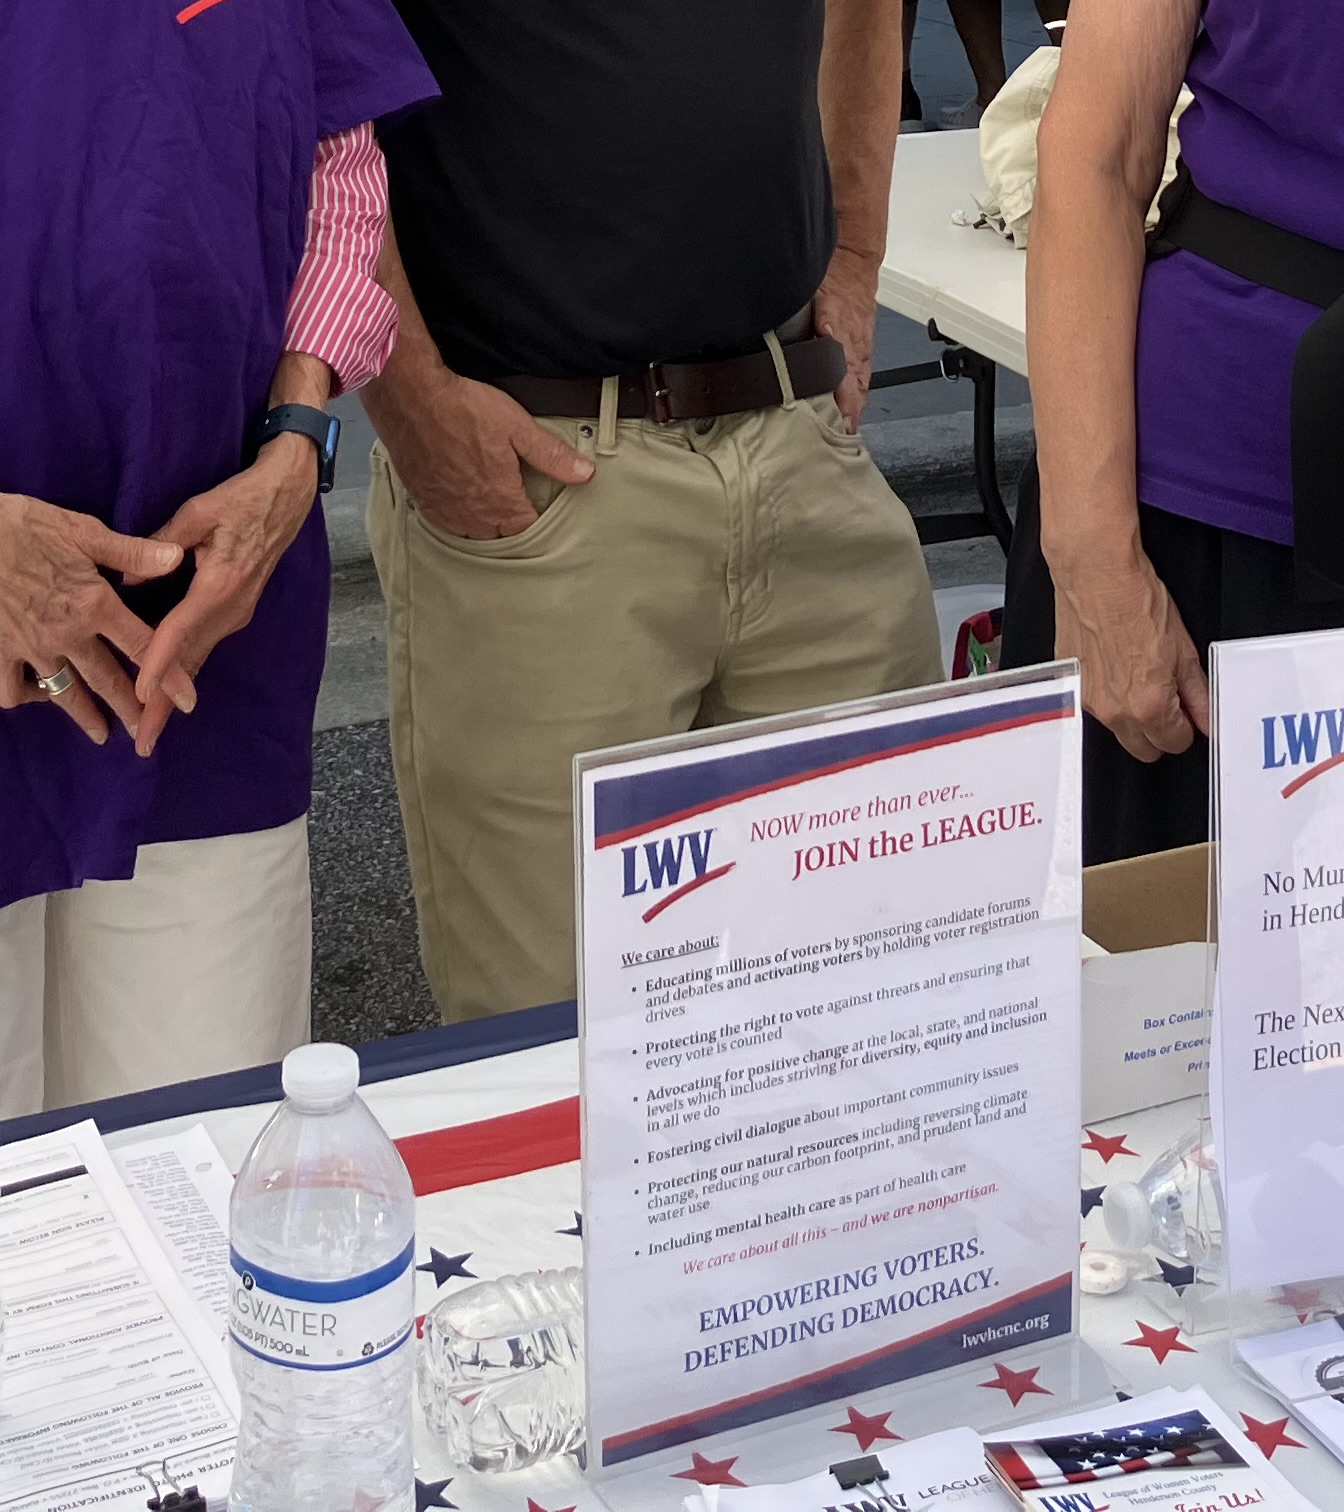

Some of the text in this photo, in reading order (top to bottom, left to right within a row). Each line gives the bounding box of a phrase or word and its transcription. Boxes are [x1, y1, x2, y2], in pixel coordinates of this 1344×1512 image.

[750, 812, 804, 843] NOW
[808, 805, 861, 831] more
[867, 794, 911, 819] than
[791, 801, 1043, 881] JOIN the LEAGUE.
[621, 828, 714, 898] LWV
[1262, 871, 1295, 896] No
[1262, 909, 1282, 932] in
[621, 951, 643, 966] We
[645, 946, 675, 961] care
[645, 897, 1031, 993] Educating millions of voters by sponsoring candidate forums
[645, 910, 1040, 1009] and debates and activating voters by holding voter registration
[645, 1005, 686, 1024] drives
[1144, 1018, 1165, 1029] Box
[1254, 1010, 1296, 1036] The
[1160, 1044, 1172, 1055] or
[1253, 1039, 1342, 1071] Election
[648, 1163, 967, 1256] Including mental health care as part of health care
[683, 1258, 704, 1275] We
[707, 1252, 736, 1269] care
[739, 1239, 779, 1261] about
[781, 1231, 799, 1249] all
[801, 1226, 827, 1244] this
[842, 1213, 868, 1233] and
[870, 1210, 891, 1225] we
[892, 1204, 915, 1219] are
[917, 1182, 998, 1213] nonpartisan.
[699, 1237, 985, 1333] EMPOWERING VOTERS.
[683, 1267, 999, 1373] DEFENDING DEMOCRACY.
[962, 1313, 1050, 1349] lwvhcnc.org
[269, 1339, 293, 1354] 500
[918, 1473, 992, 1500] LEAGUE
